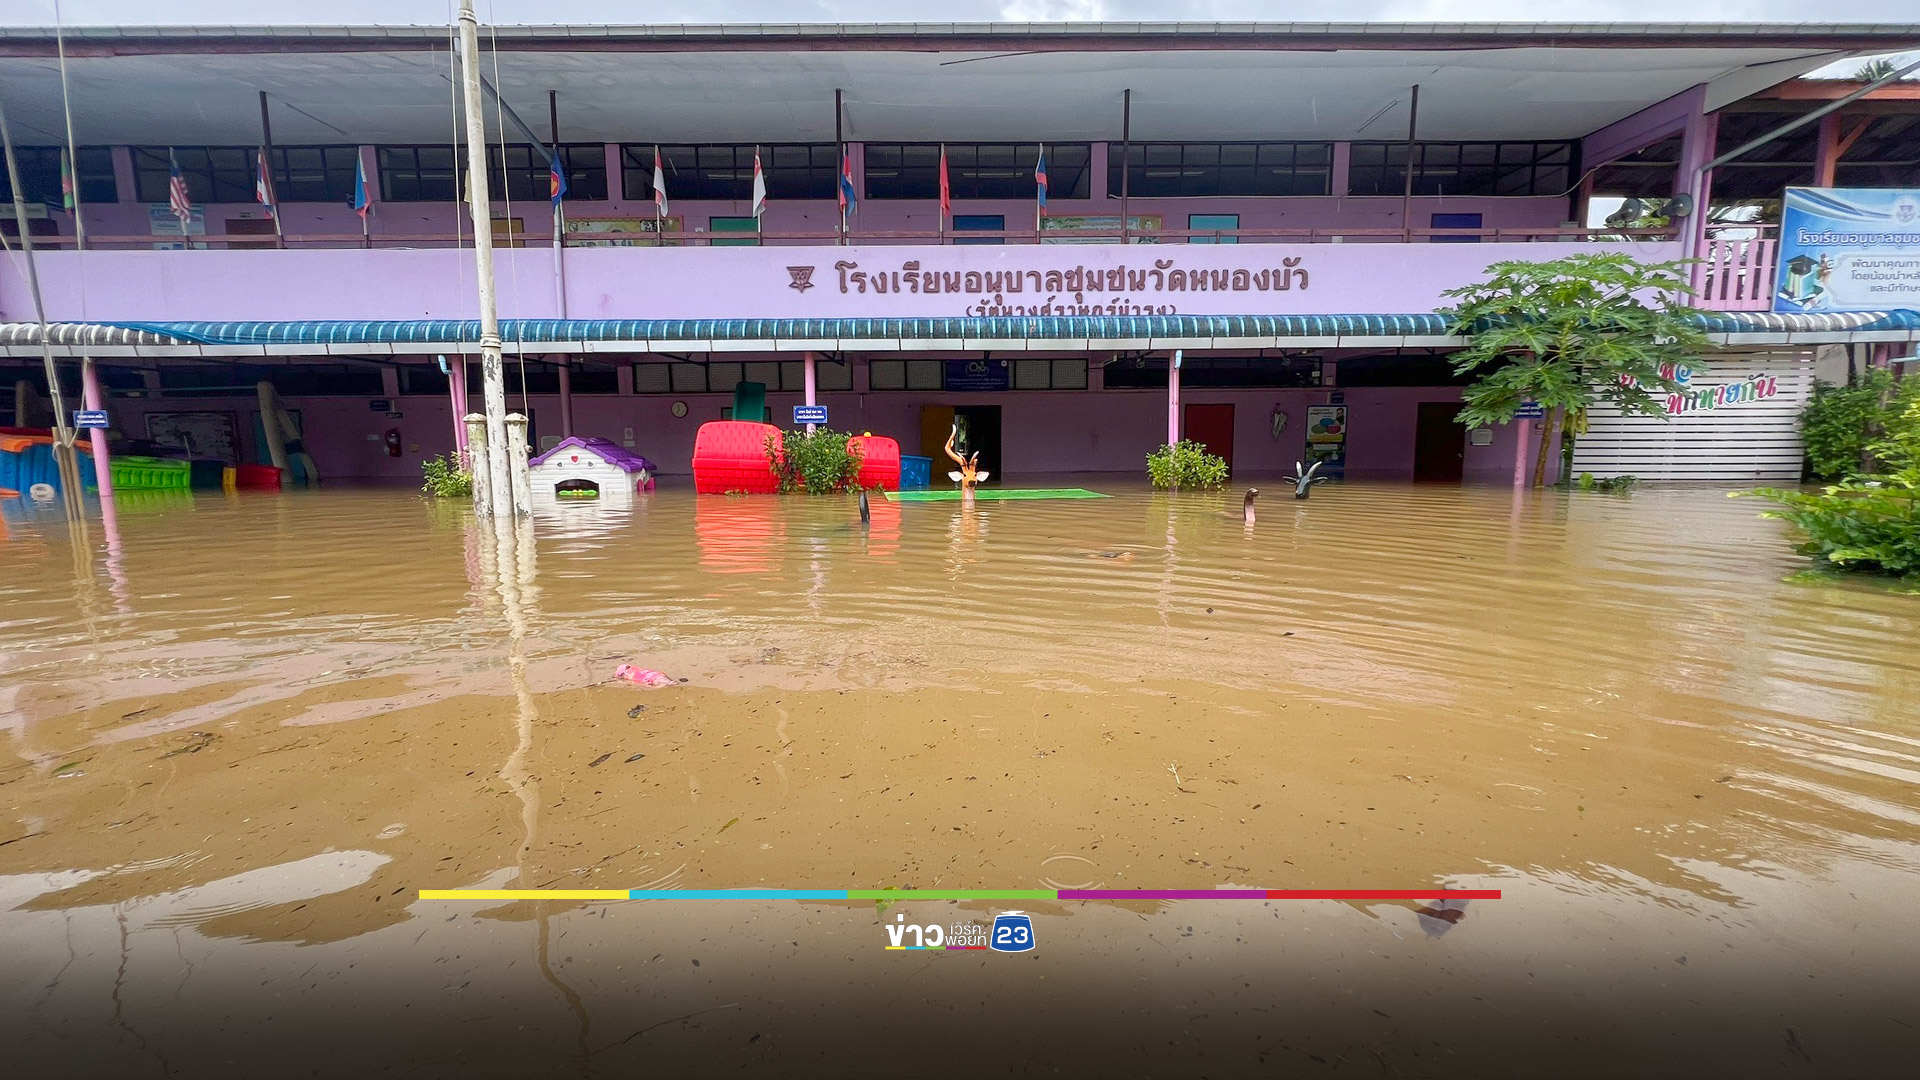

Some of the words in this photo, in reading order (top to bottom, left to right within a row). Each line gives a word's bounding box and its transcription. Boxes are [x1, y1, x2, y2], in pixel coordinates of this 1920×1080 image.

[834, 257, 1310, 302] โรงเรียนอนุบาลชุมชนวัดหนองบัว
[1666, 373, 1777, 415] ทกทายกัน
